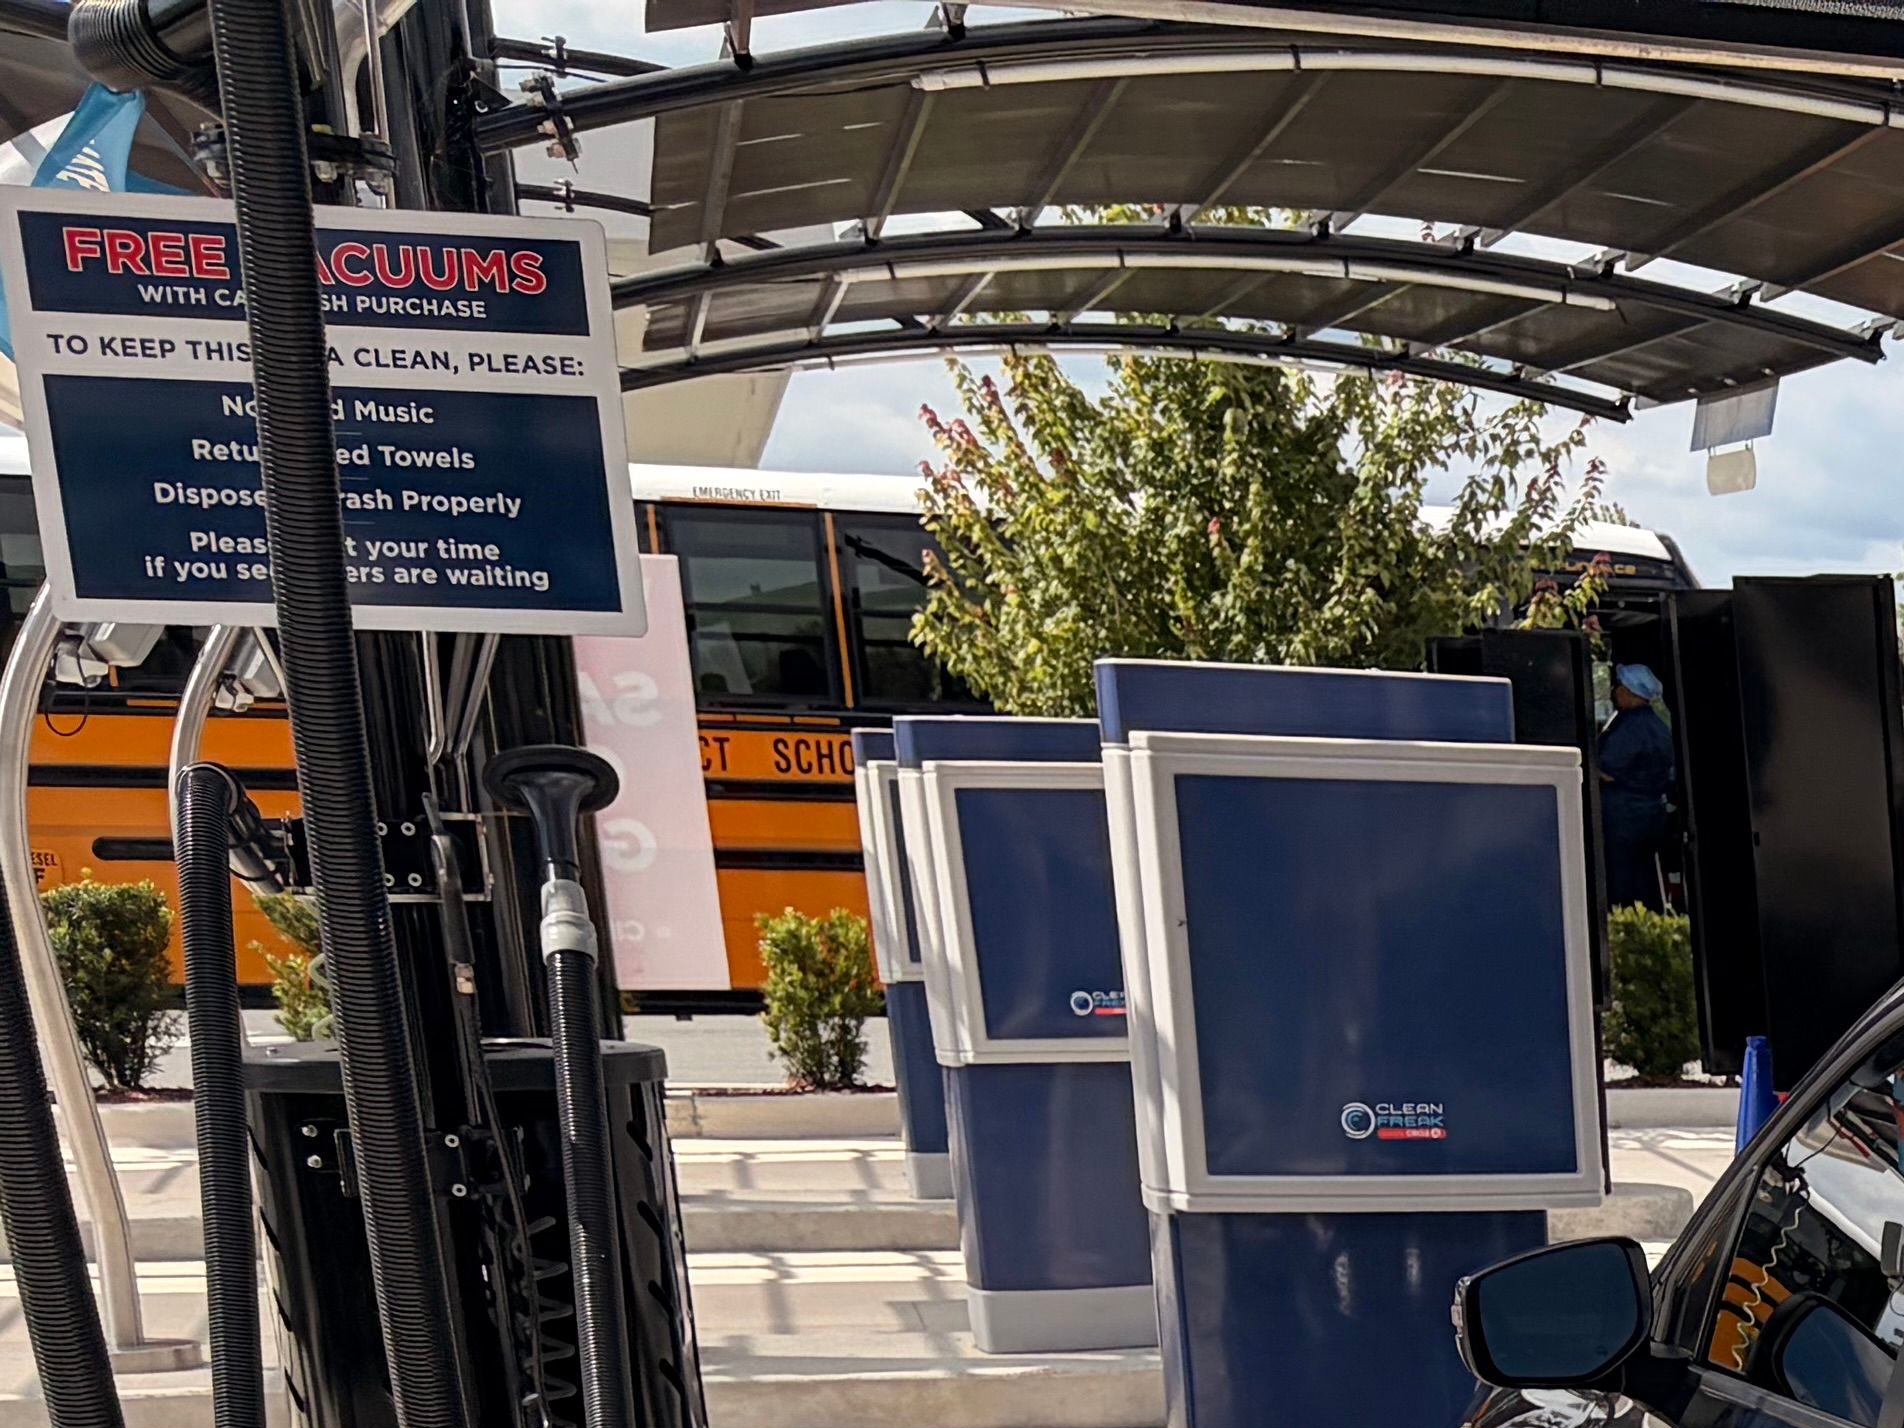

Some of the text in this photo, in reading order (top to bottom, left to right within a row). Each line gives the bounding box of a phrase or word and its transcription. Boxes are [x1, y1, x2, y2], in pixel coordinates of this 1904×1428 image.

[63, 226, 548, 296] FREE CUUMS
[137, 284, 487, 319] WITH CA SH PURCHASE
[46, 333, 88, 357] TO
[99, 336, 176, 360] KEEP
[186, 340, 252, 363] THIS
[354, 348, 459, 376] CLEAN,
[469, 352, 586, 378] PLEASE:
[355, 400, 435, 426] Music
[192, 439, 476, 471] Retu ed Towels
[154, 482, 522, 518] Dispose rash Properly
[693, 485, 781, 501] EMERGENCY EXIT
[190, 531, 268, 555] Pleas
[366, 543, 428, 564] your
[436, 537, 500, 561] time
[145, 556, 165, 579] if
[173, 560, 228, 584] you
[394, 568, 437, 586] are
[446, 566, 549, 592] waiting
[773, 738, 854, 775] SCHO
[31, 852, 58, 866] ESEL
[1375, 1103, 1444, 1115] CLEAN
[1376, 1116, 1444, 1127] FREAK
